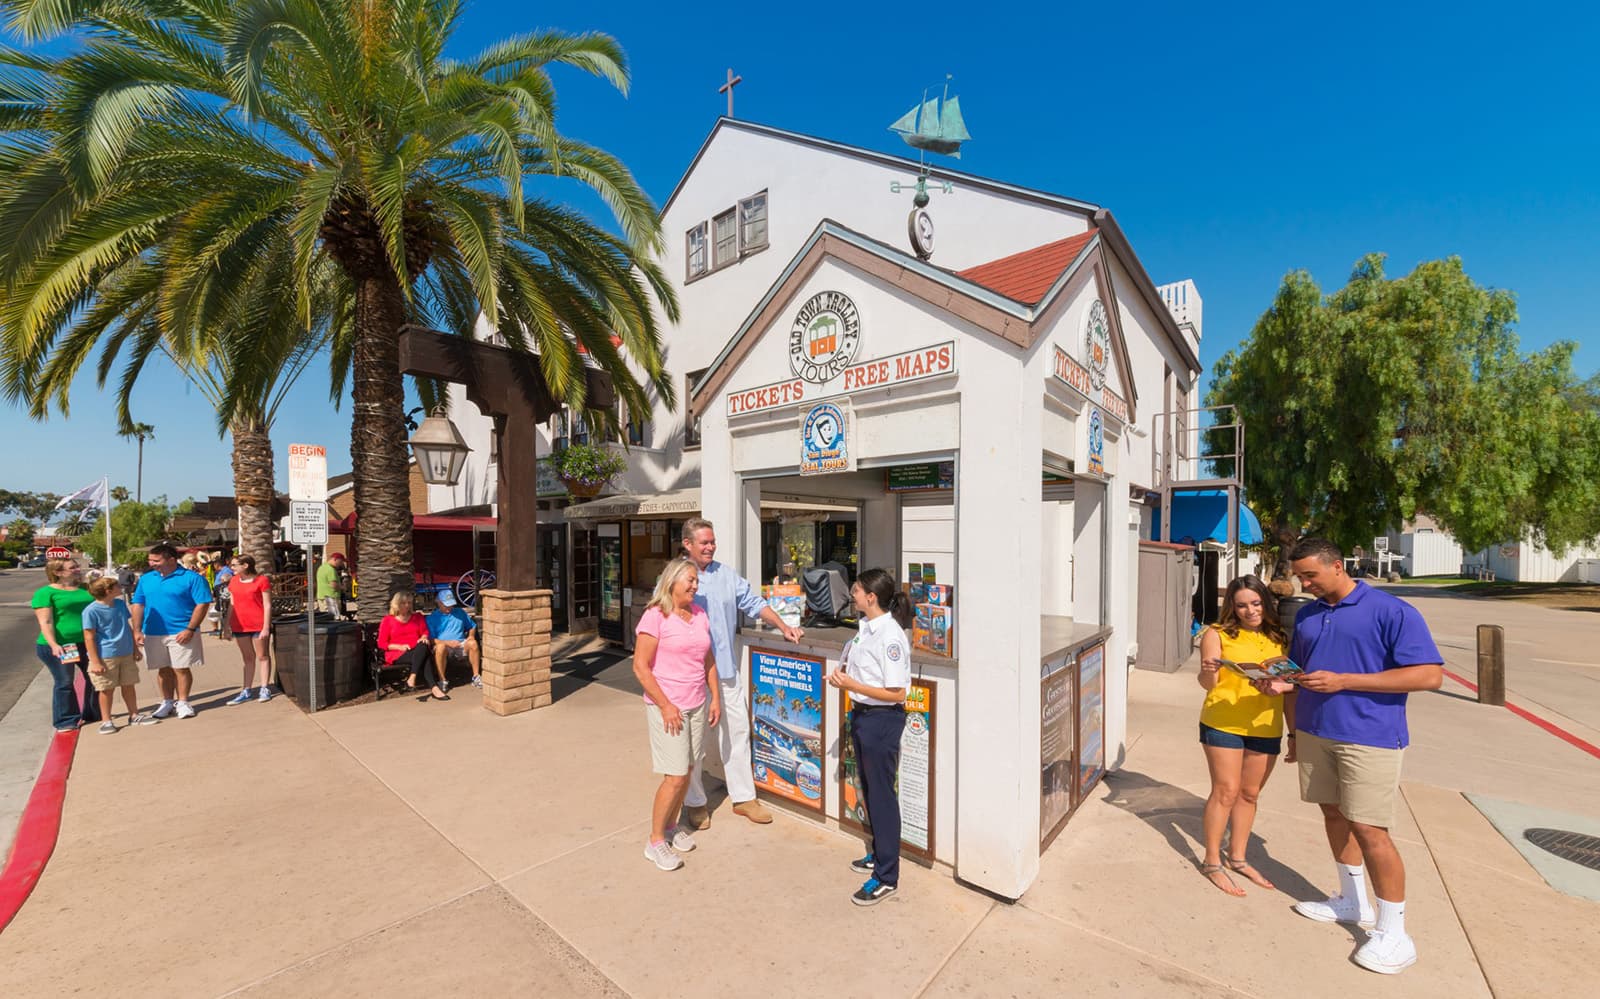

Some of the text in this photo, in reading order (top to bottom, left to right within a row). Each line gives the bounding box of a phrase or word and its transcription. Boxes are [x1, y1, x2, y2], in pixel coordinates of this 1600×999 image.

[791, 292, 859, 355] OLD TOWN TROLLEY
[799, 350, 851, 382] TOURS
[843, 346, 950, 391] FREE MAPS
[1055, 350, 1091, 397] TICKETS
[729, 381, 804, 415] TICKETS
[291, 446, 325, 457] BEGIN
[801, 457, 848, 472] SEAL TOURS
[759, 655, 812, 672] View America's
[759, 665, 778, 676] Finest
[797, 672, 806, 681] On
[759, 675, 814, 692] BOAT WITH WHEELS
